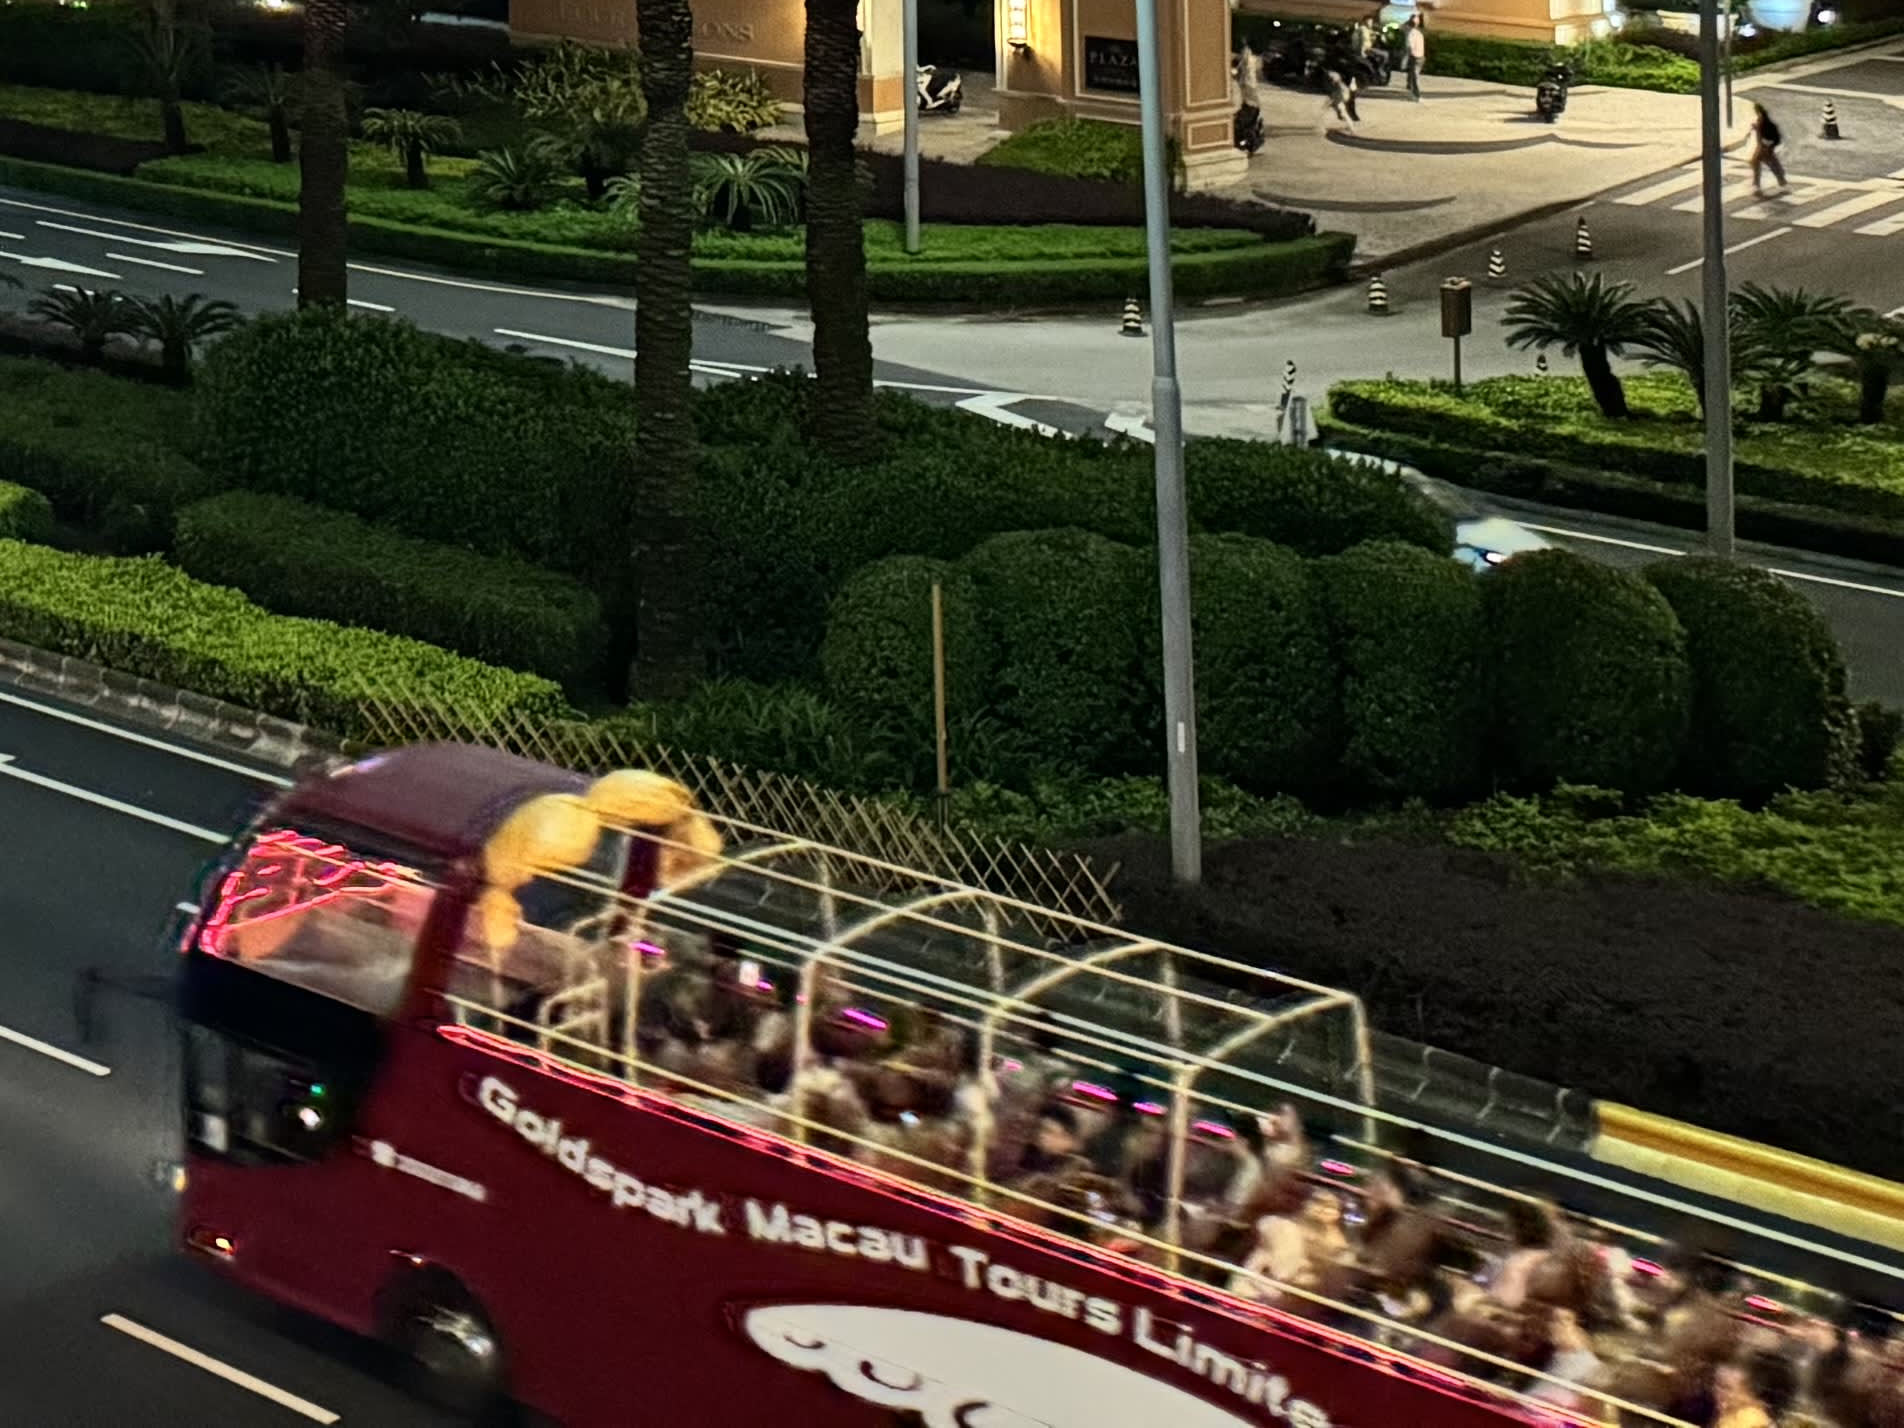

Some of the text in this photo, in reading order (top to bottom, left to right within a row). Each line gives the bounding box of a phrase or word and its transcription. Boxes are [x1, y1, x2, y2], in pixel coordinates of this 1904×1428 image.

[478, 1075, 726, 1235] Goldspark
[744, 1197, 930, 1271] Macau
[949, 1245, 1123, 1336] Tours
